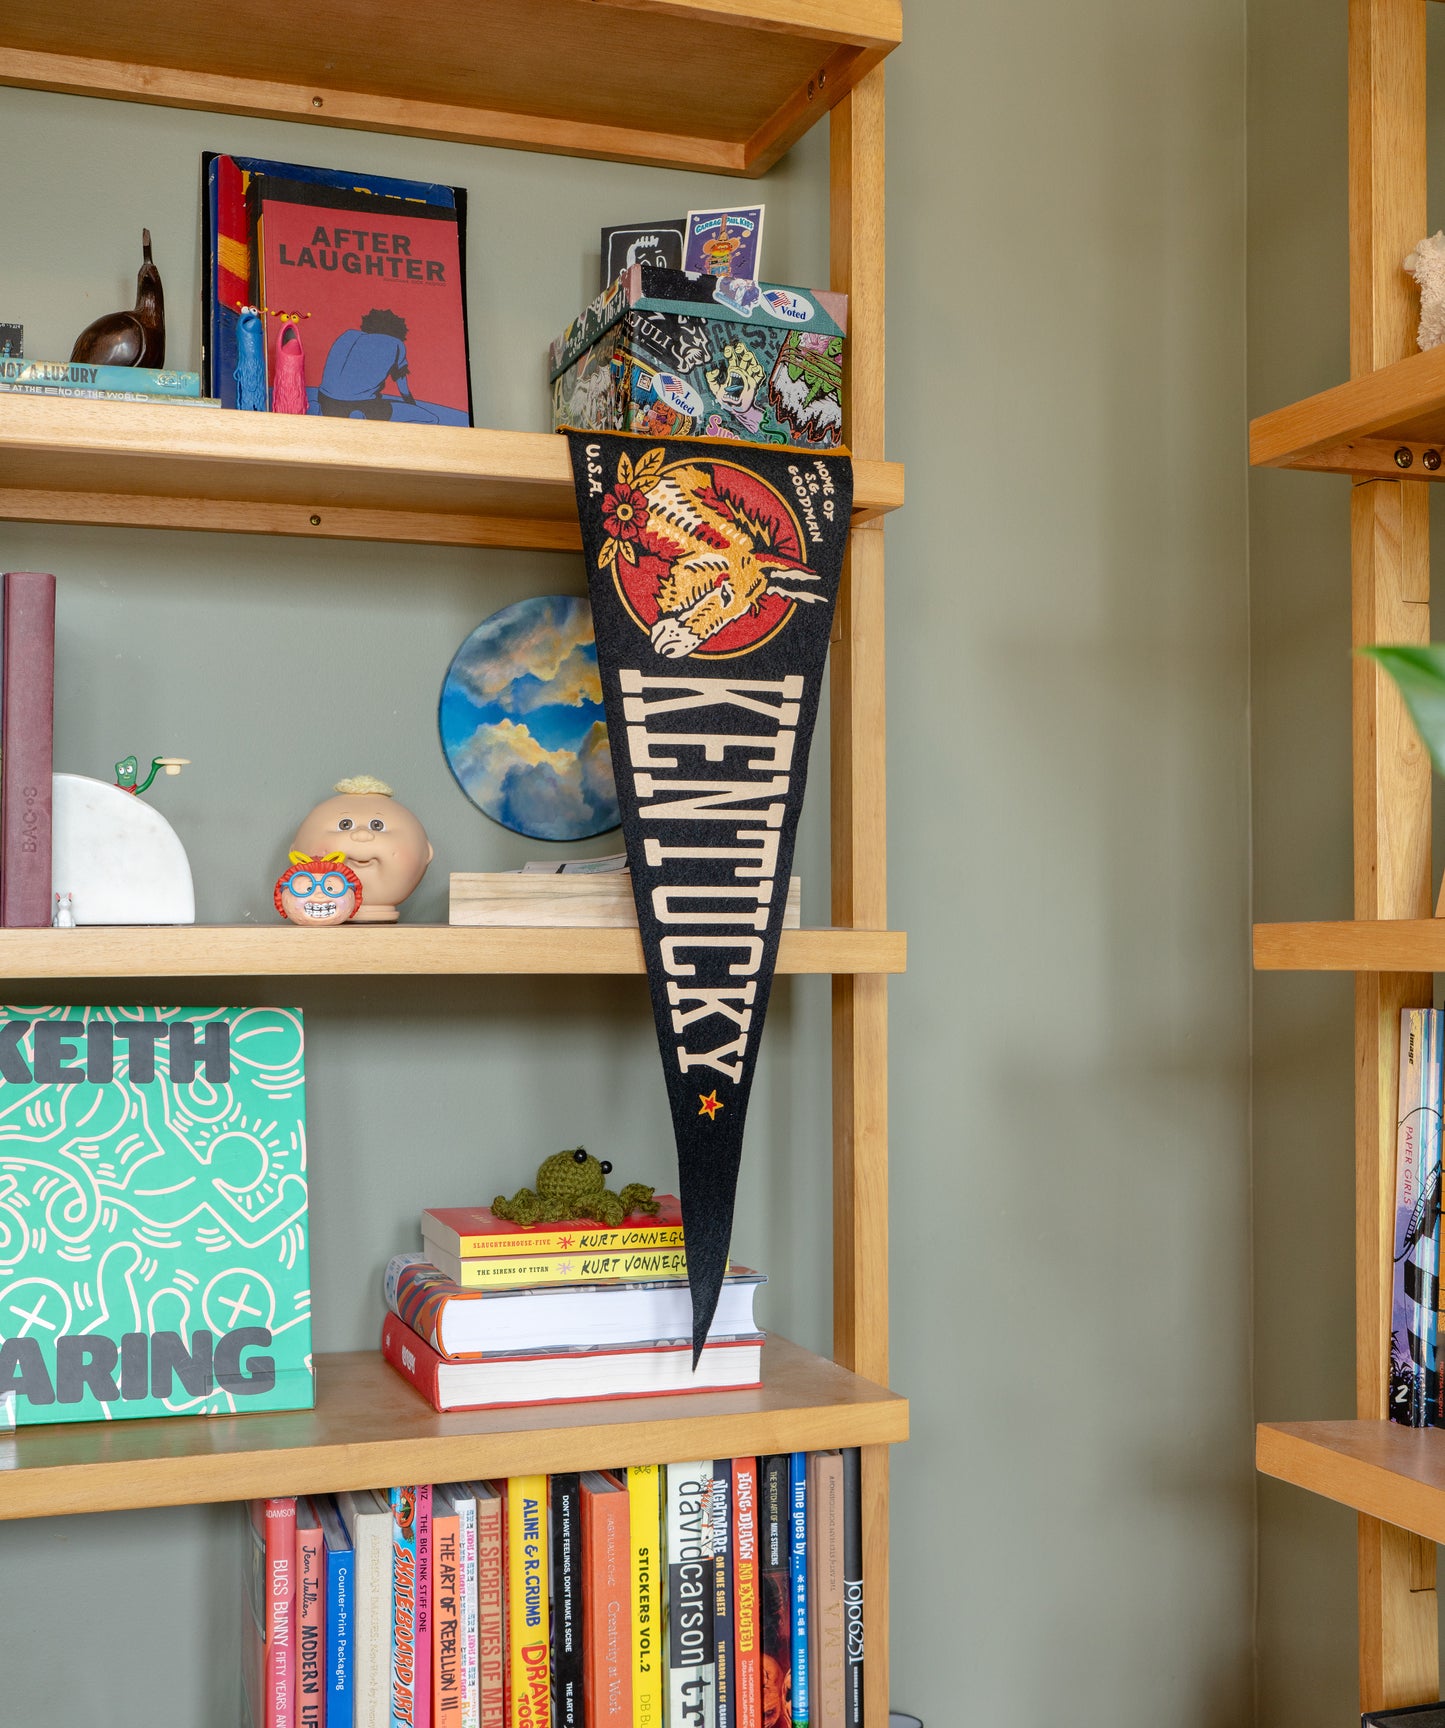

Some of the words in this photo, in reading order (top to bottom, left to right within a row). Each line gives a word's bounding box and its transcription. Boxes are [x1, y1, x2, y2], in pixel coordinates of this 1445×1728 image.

[695, 217, 722, 234] GARBAG
[311, 226, 412, 256] AFTER
[279, 244, 447, 282] LAUGHTER
[781, 305, 807, 320] Voted
[791, 299, 797, 308] I
[29, 363, 38, 380] A
[43, 364, 98, 384] LUXURY
[25, 386, 42, 394] THE
[44, 387, 72, 397] END
[74, 388, 84, 397] OF
[84, 390, 105, 399] THE
[106, 391, 149, 401] WORLD
[671, 392, 695, 415] Voted
[684, 391, 691, 399] I
[585, 444, 603, 497] U.S.A.
[804, 472, 820, 495] S.G.
[813, 460, 835, 496] HOME
[787, 465, 824, 542] GOODMAN
[823, 500, 835, 522] OF
[619, 669, 805, 1084] KENTUCKY
[1407, 1033, 1415, 1065] image
[1405, 1126, 1414, 1165] PAPER
[1403, 1173, 1412, 1205] GIRLS
[579, 1233, 619, 1248] KURT
[580, 1258, 620, 1275] KURT
[0, 1326, 275, 1406] ARING
[1395, 1384, 1408, 1403] 2
[562, 1495, 570, 1517] DON'T
[770, 1481, 778, 1503] SKETCH
[795, 1479, 806, 1508] Time
[523, 1498, 539, 1541] ALINE
[712, 1479, 728, 1553] NIGHTMARE
[770, 1503, 778, 1514] ART
[420, 1514, 428, 1534] THE
[480, 1511, 499, 1542] THE
[607, 1513, 616, 1563] HABITUALLY
[737, 1510, 754, 1560] DRAWN
[770, 1522, 778, 1537] MIKE
[793, 1512, 804, 1539] goes
[303, 1546, 316, 1574] Jean
[420, 1538, 428, 1554] BIG
[440, 1533, 455, 1562] THE
[524, 1544, 538, 1558] &
[562, 1538, 570, 1575] FEELINGS,
[770, 1537, 779, 1566] STEPHENS
[420, 1558, 428, 1584] PINK
[607, 1563, 616, 1587] CHIC
[716, 1555, 725, 1569] ON
[739, 1563, 753, 1581] AND
[273, 1560, 288, 1595] BUGS
[440, 1564, 455, 1595] ART
[480, 1547, 500, 1607] SECRET
[563, 1576, 571, 1598] DON'T
[639, 1547, 650, 1624] STICKERS
[716, 1570, 725, 1588] ONE
[302, 1578, 318, 1618] Jullien
[338, 1567, 347, 1636] Counter-Print
[440, 1597, 456, 1617] OF
[716, 1590, 726, 1617] SHEET
[273, 1601, 289, 1647] BUNNY
[393, 1542, 416, 1685] SKATEBOARD
[419, 1611, 427, 1632] ONE
[738, 1582, 755, 1652] EXECUTED
[480, 1609, 500, 1656] LIVES
[605, 1601, 621, 1662] Creativity
[275, 1651, 287, 1676] FIFTY
[302, 1625, 319, 1694] MODERN
[440, 1619, 458, 1690] REBELLION
[639, 1627, 651, 1673] VOL.2
[336, 1640, 347, 1691] Packaging
[481, 1660, 501, 1682] OF
[608, 1666, 619, 1677] at
[718, 1653, 726, 1679] HORROR
[275, 1680, 287, 1710] YEARS
[608, 1680, 621, 1715] Work
[718, 1680, 726, 1693] ART
[718, 1694, 726, 1703] OF
[394, 1681, 414, 1725] ART
[440, 1696, 459, 1711] III
[481, 1687, 502, 1728] MEN
[640, 1694, 651, 1711] DB
[680, 1676, 711, 1728] tr
[566, 1714, 573, 1724] OF
